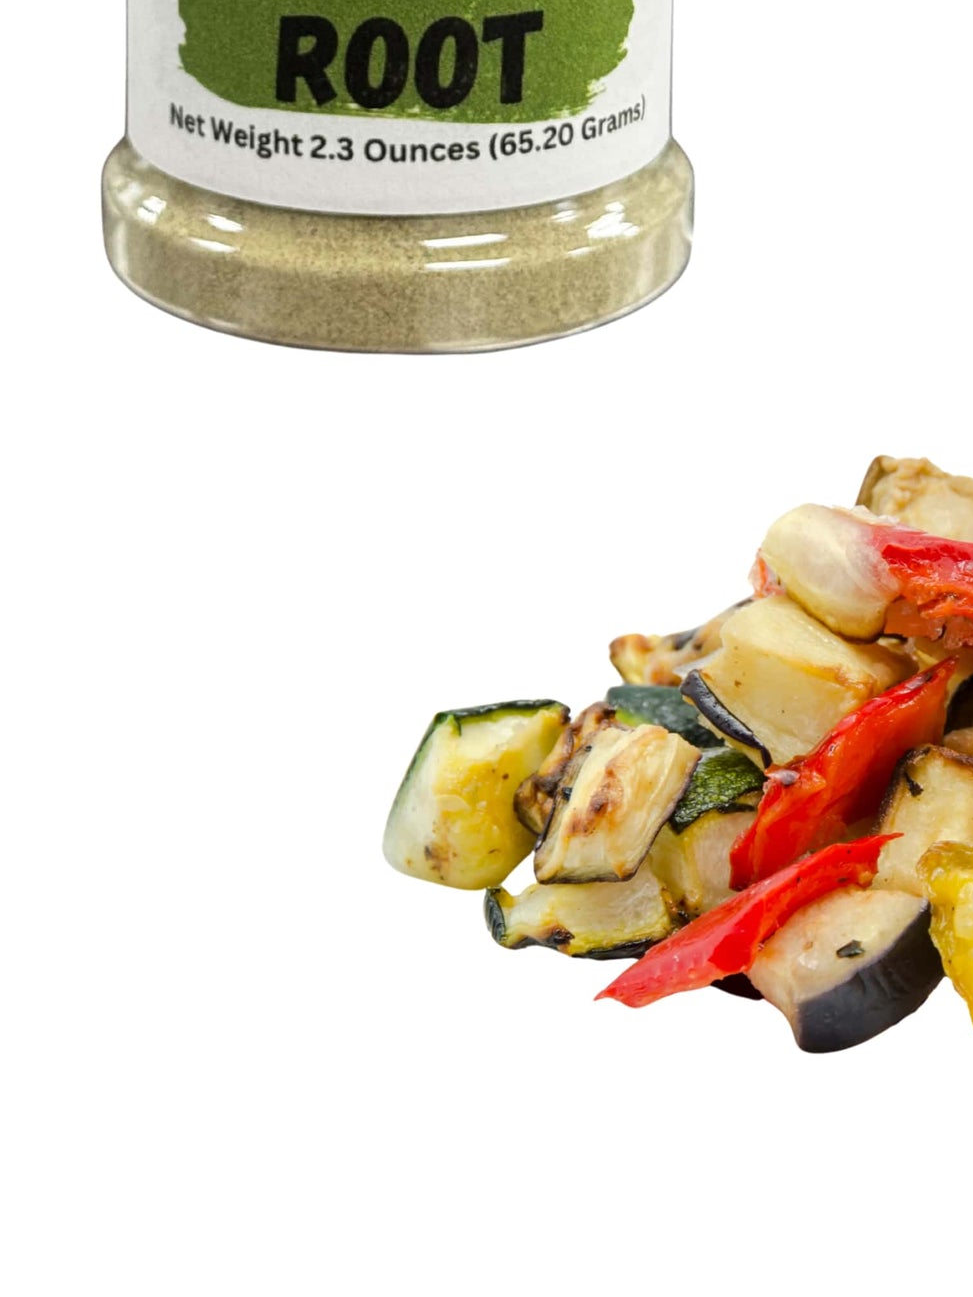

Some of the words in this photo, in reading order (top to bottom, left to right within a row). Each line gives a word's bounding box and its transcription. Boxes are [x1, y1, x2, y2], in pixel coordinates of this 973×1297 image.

[274, 10, 545, 110] ROOT
[169, 102, 205, 138] Net
[210, 116, 304, 160] Weight
[310, 134, 354, 161] 2.3
[363, 138, 481, 163] Ounces
[488, 122, 575, 161] (65.20
[580, 93, 646, 140] Grams)
